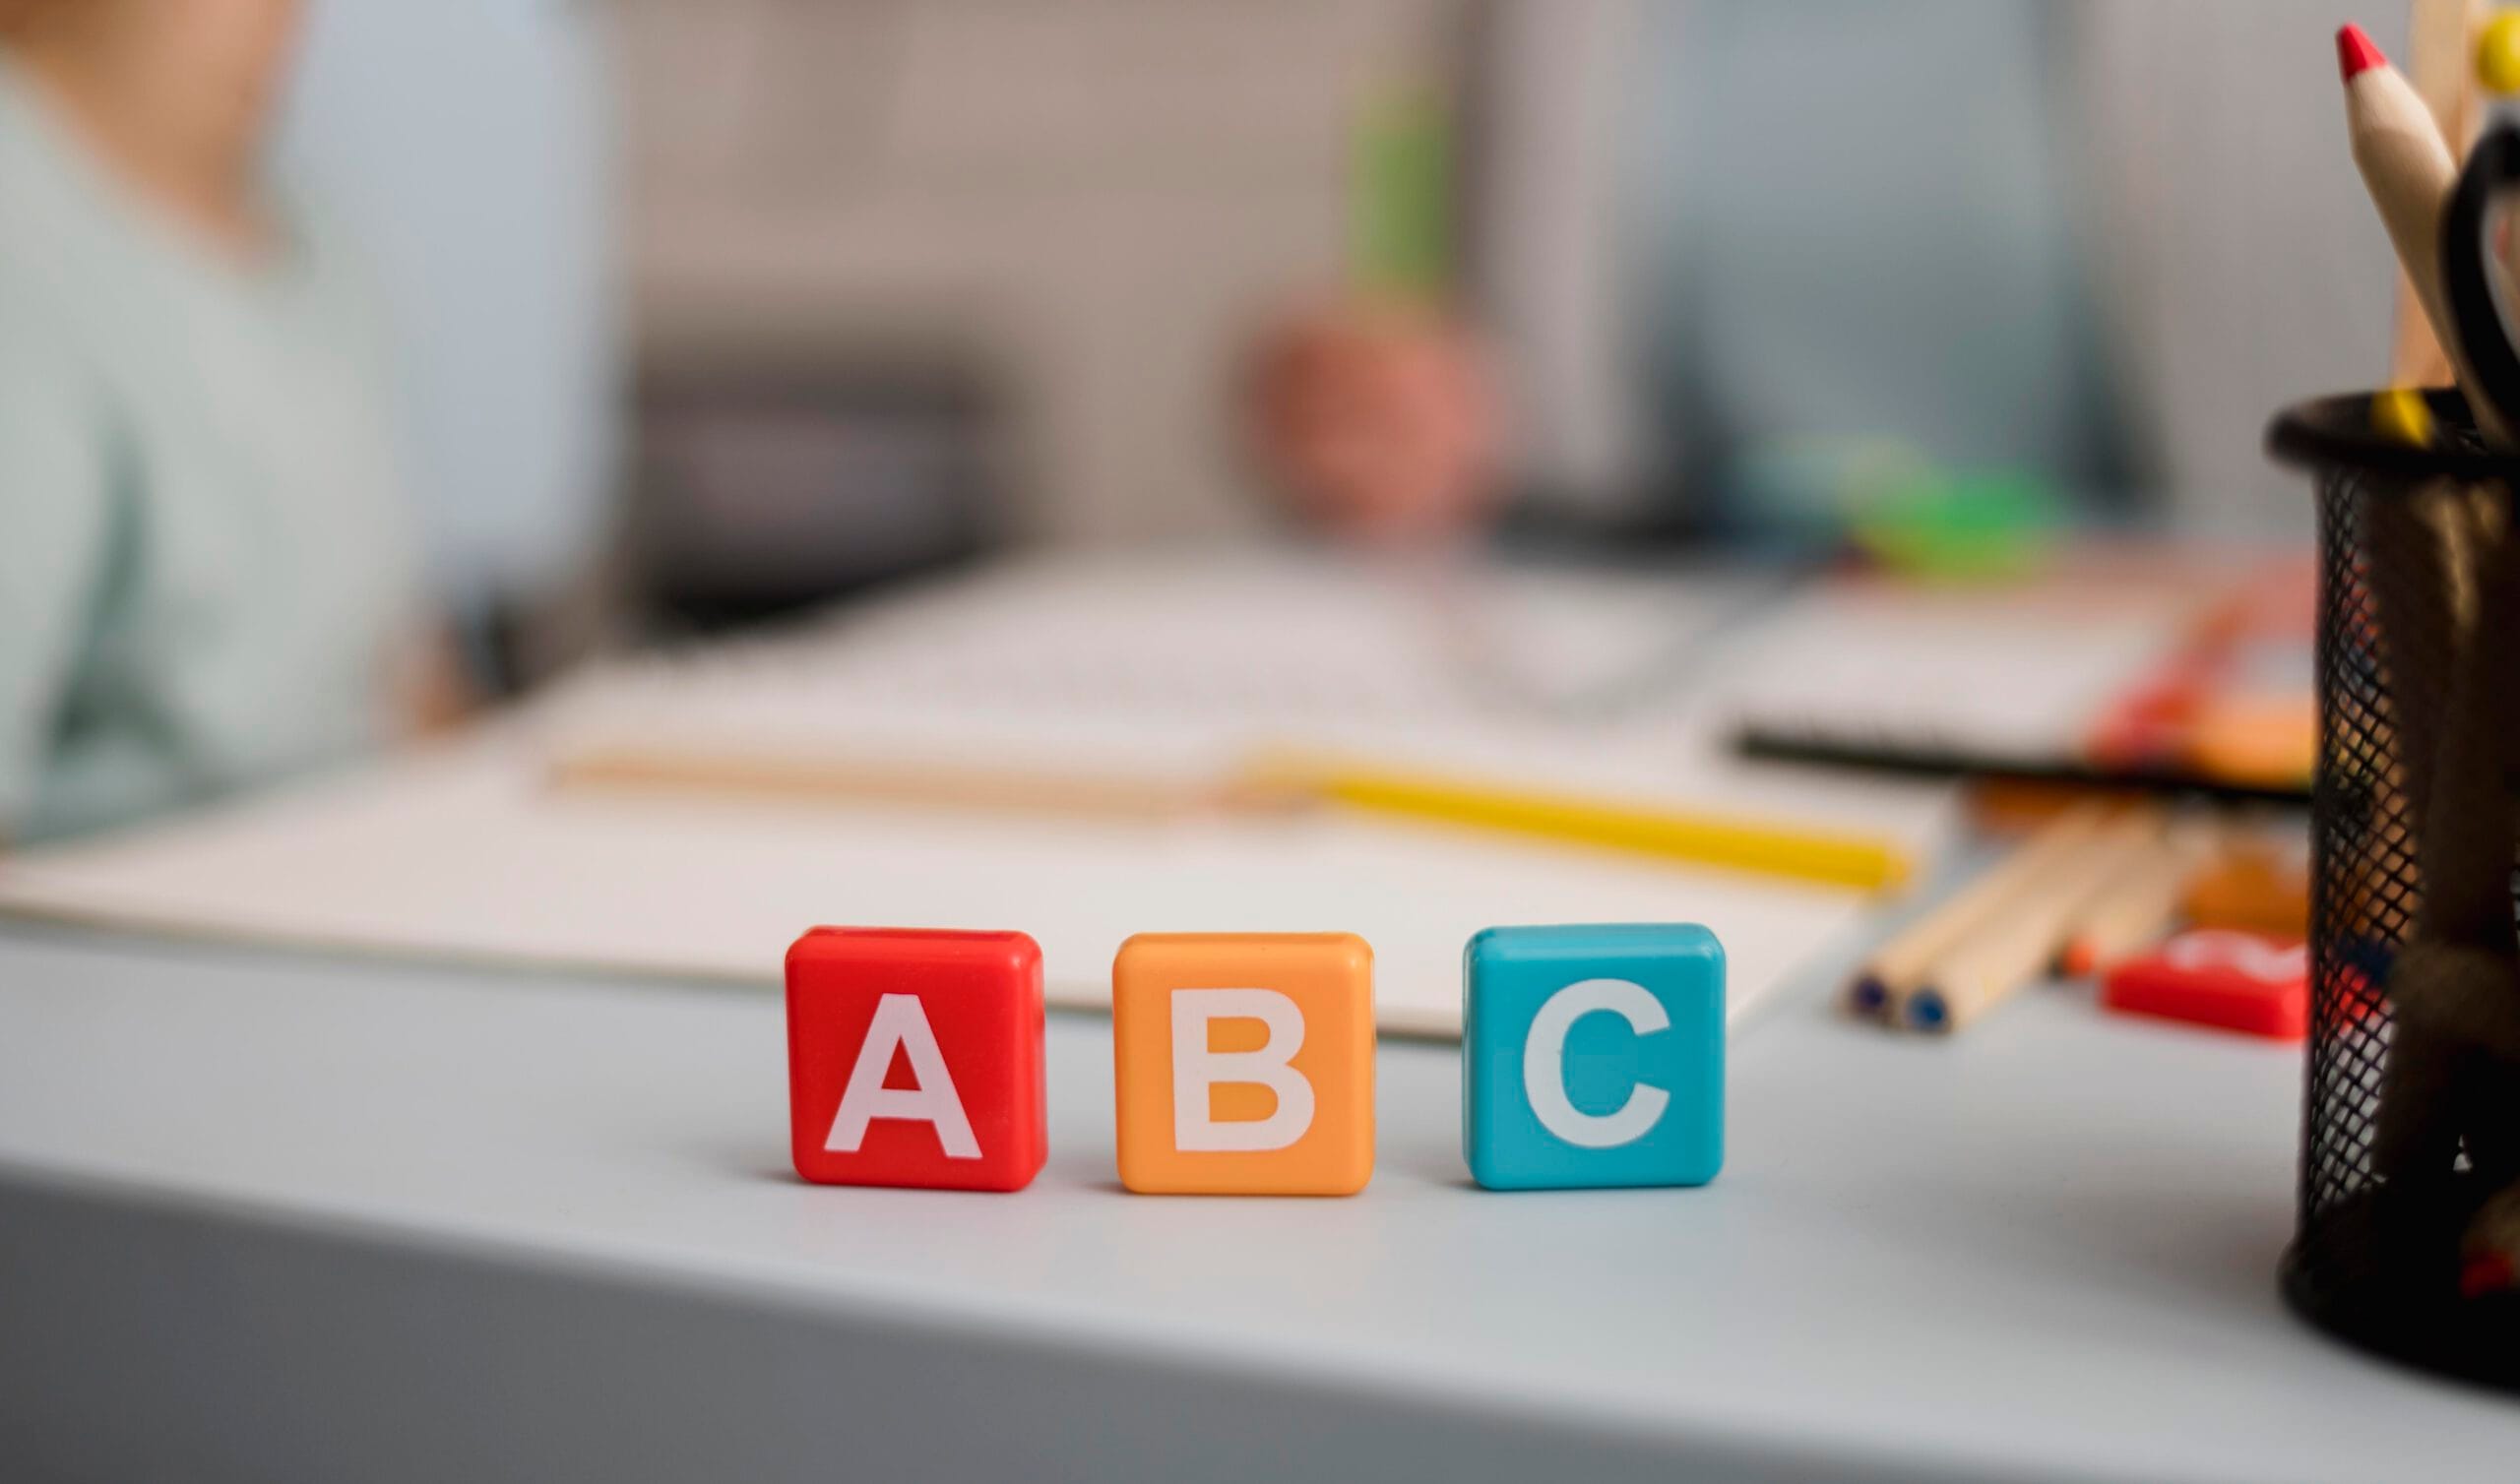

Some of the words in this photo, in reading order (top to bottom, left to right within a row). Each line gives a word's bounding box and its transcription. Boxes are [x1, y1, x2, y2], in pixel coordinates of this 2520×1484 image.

[825, 994, 981, 1159] A
[1170, 988, 1316, 1152] B
[1523, 978, 1670, 1148] C
